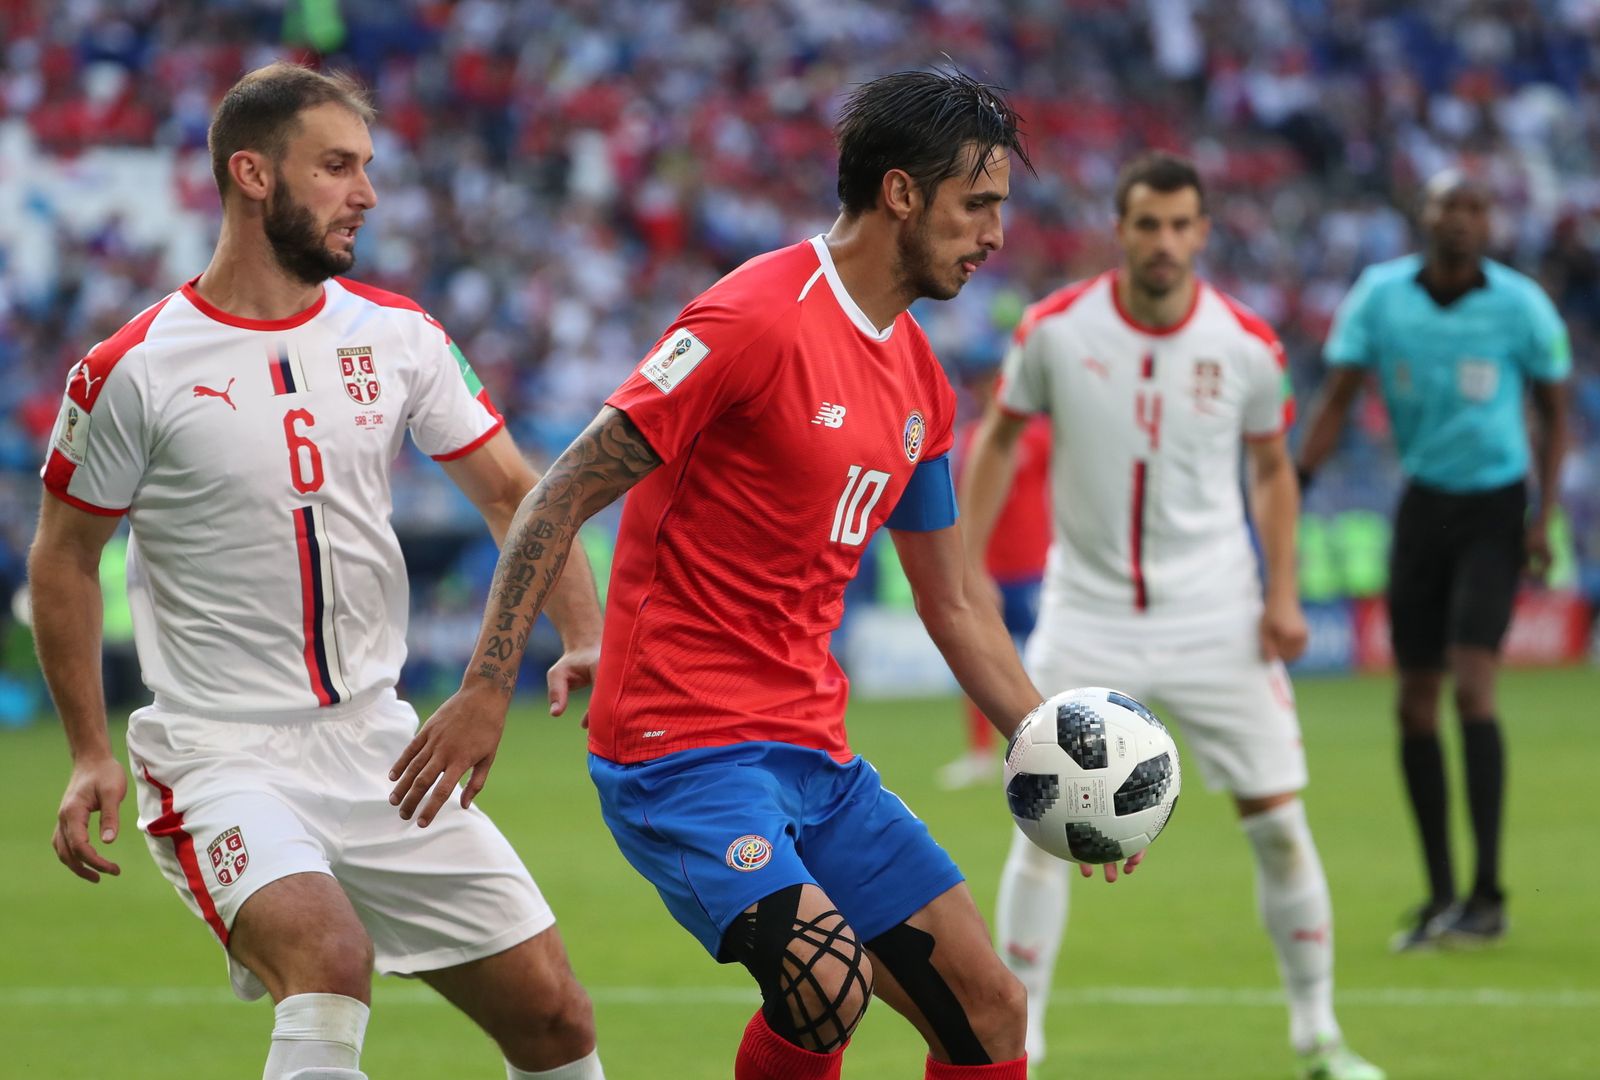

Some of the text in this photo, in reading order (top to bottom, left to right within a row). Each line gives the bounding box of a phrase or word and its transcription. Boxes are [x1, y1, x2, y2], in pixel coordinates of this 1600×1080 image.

[283, 408, 324, 494] 6
[1136, 391, 1164, 451] 4
[830, 465, 892, 546] 10
[484, 635, 513, 662] 20
